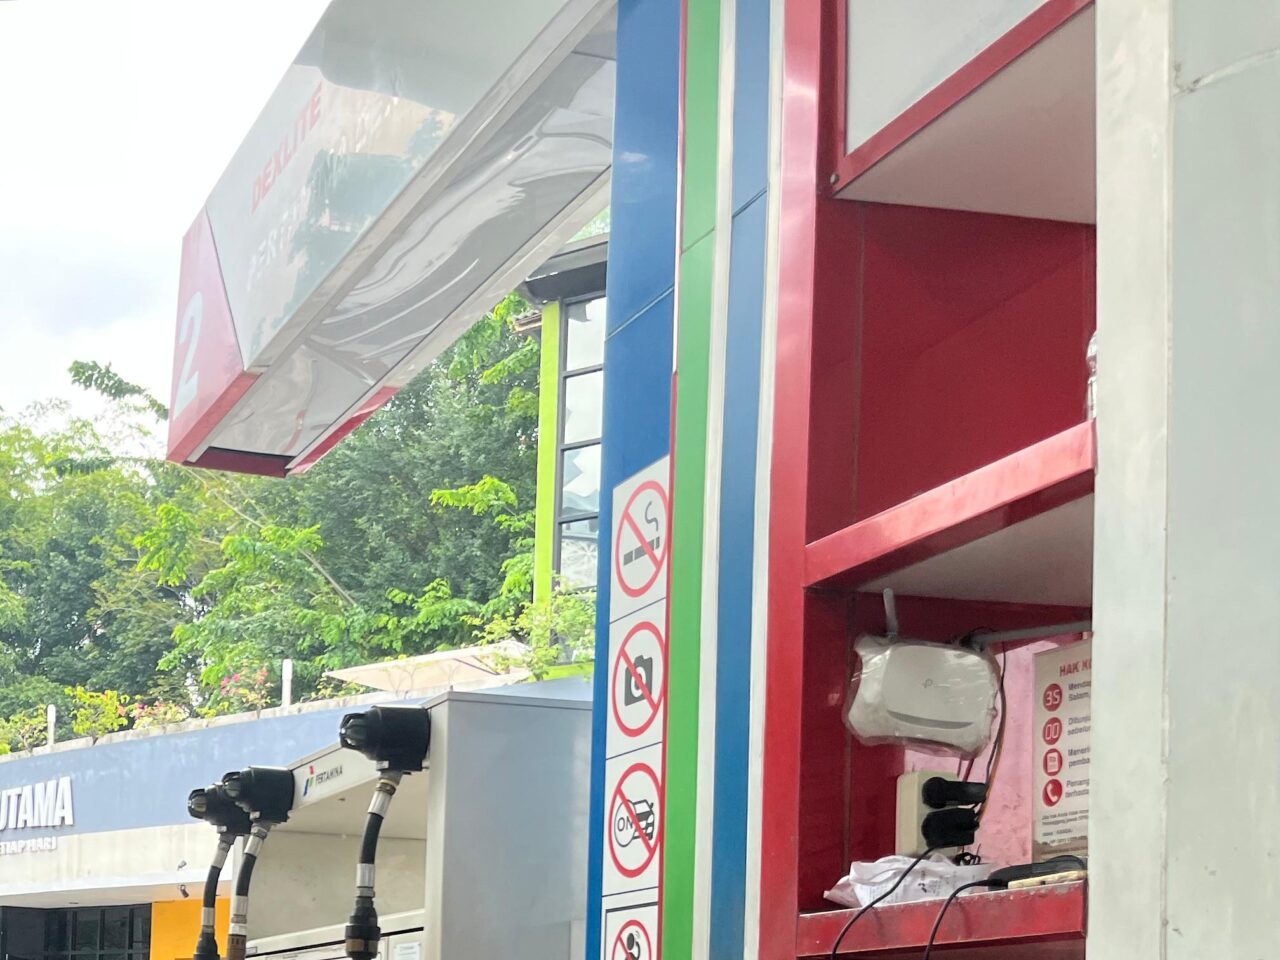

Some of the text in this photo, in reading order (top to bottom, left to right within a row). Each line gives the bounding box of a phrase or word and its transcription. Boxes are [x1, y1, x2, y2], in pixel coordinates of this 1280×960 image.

[251, 80, 323, 215] DEXLITE
[173, 291, 203, 421] 2
[1059, 663, 1079, 677] HAK
[314, 765, 343, 786] PERTAMINA
[617, 816, 634, 832] ON
